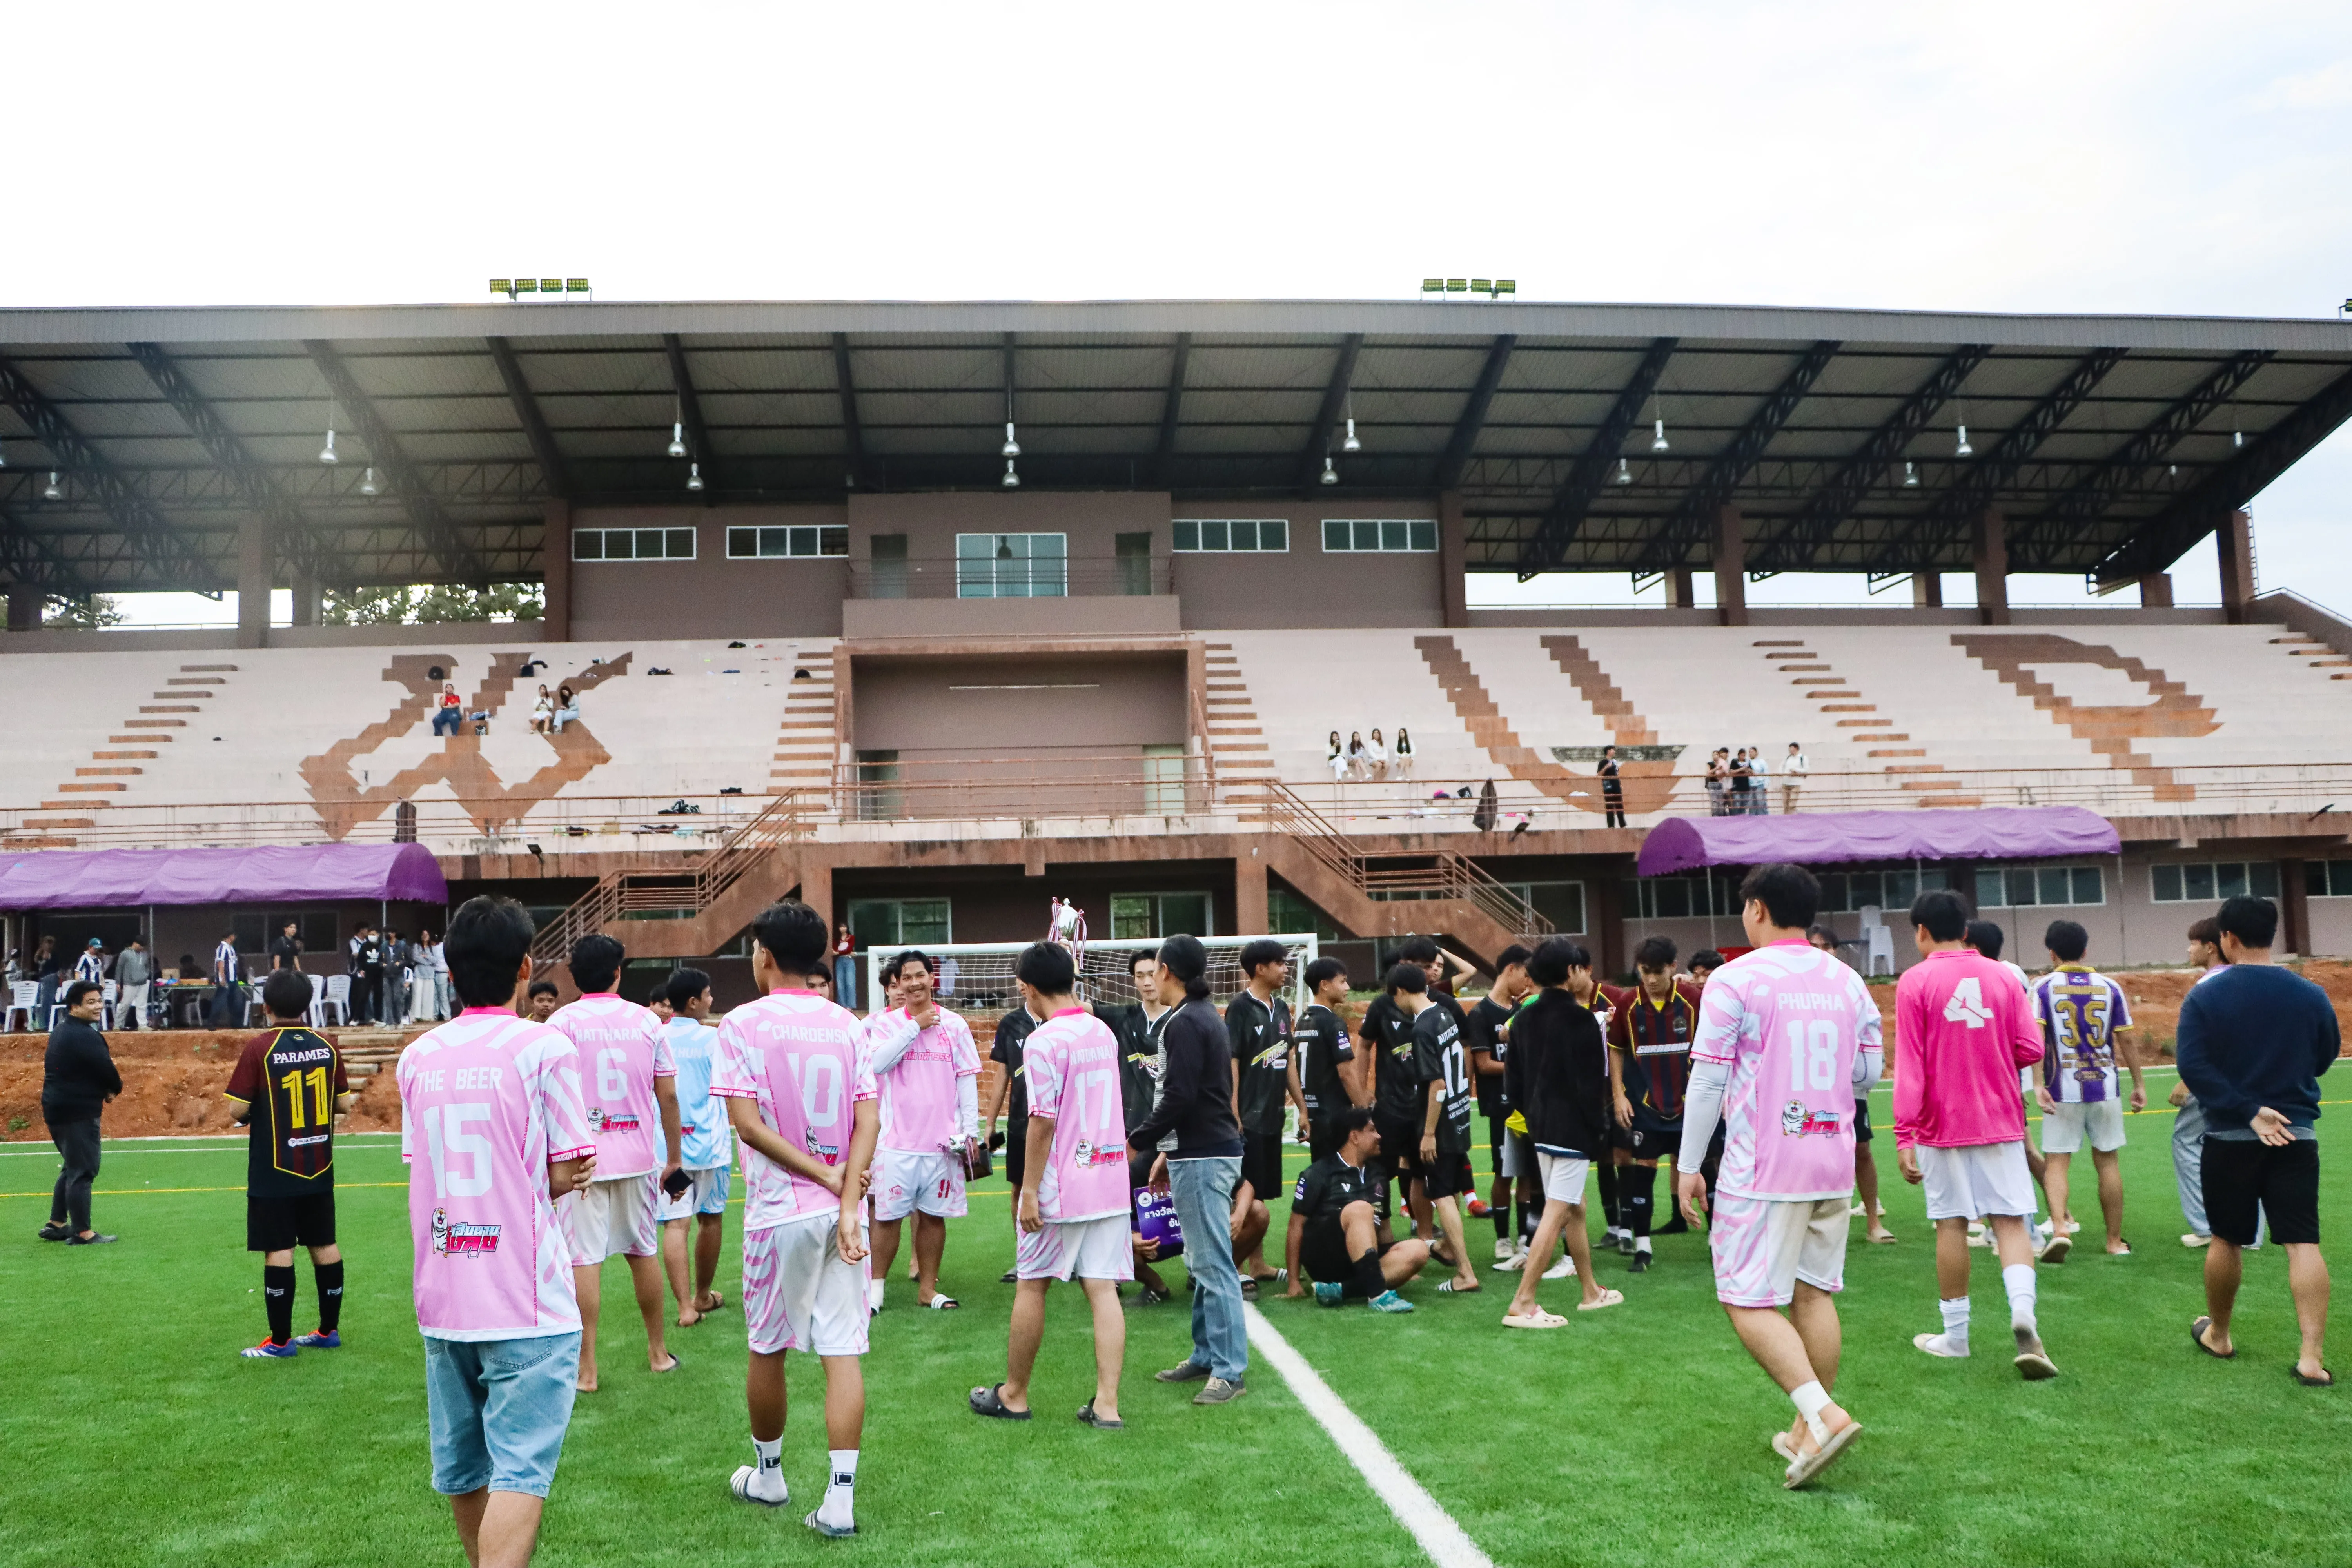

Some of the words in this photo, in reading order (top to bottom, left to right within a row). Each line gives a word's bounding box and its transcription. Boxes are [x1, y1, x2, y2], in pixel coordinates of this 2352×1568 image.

[1778, 993, 1845, 1011] PHUPHA
[1943, 976, 1993, 1028] 4
[2055, 999, 2107, 1048] 35
[272, 1048, 330, 1064] PARAMES
[772, 1024, 851, 1046] CHAROENSIN
[1786, 1019, 1839, 1091] 18
[417, 1069, 446, 1093] THE
[455, 1067, 503, 1090] BEER
[596, 1048, 627, 1101] 6
[788, 1052, 842, 1127] 10
[1442, 1040, 1468, 1098] 12
[282, 1067, 329, 1129] 11
[1074, 1068, 1113, 1132] 17
[423, 1103, 492, 1199] 15
